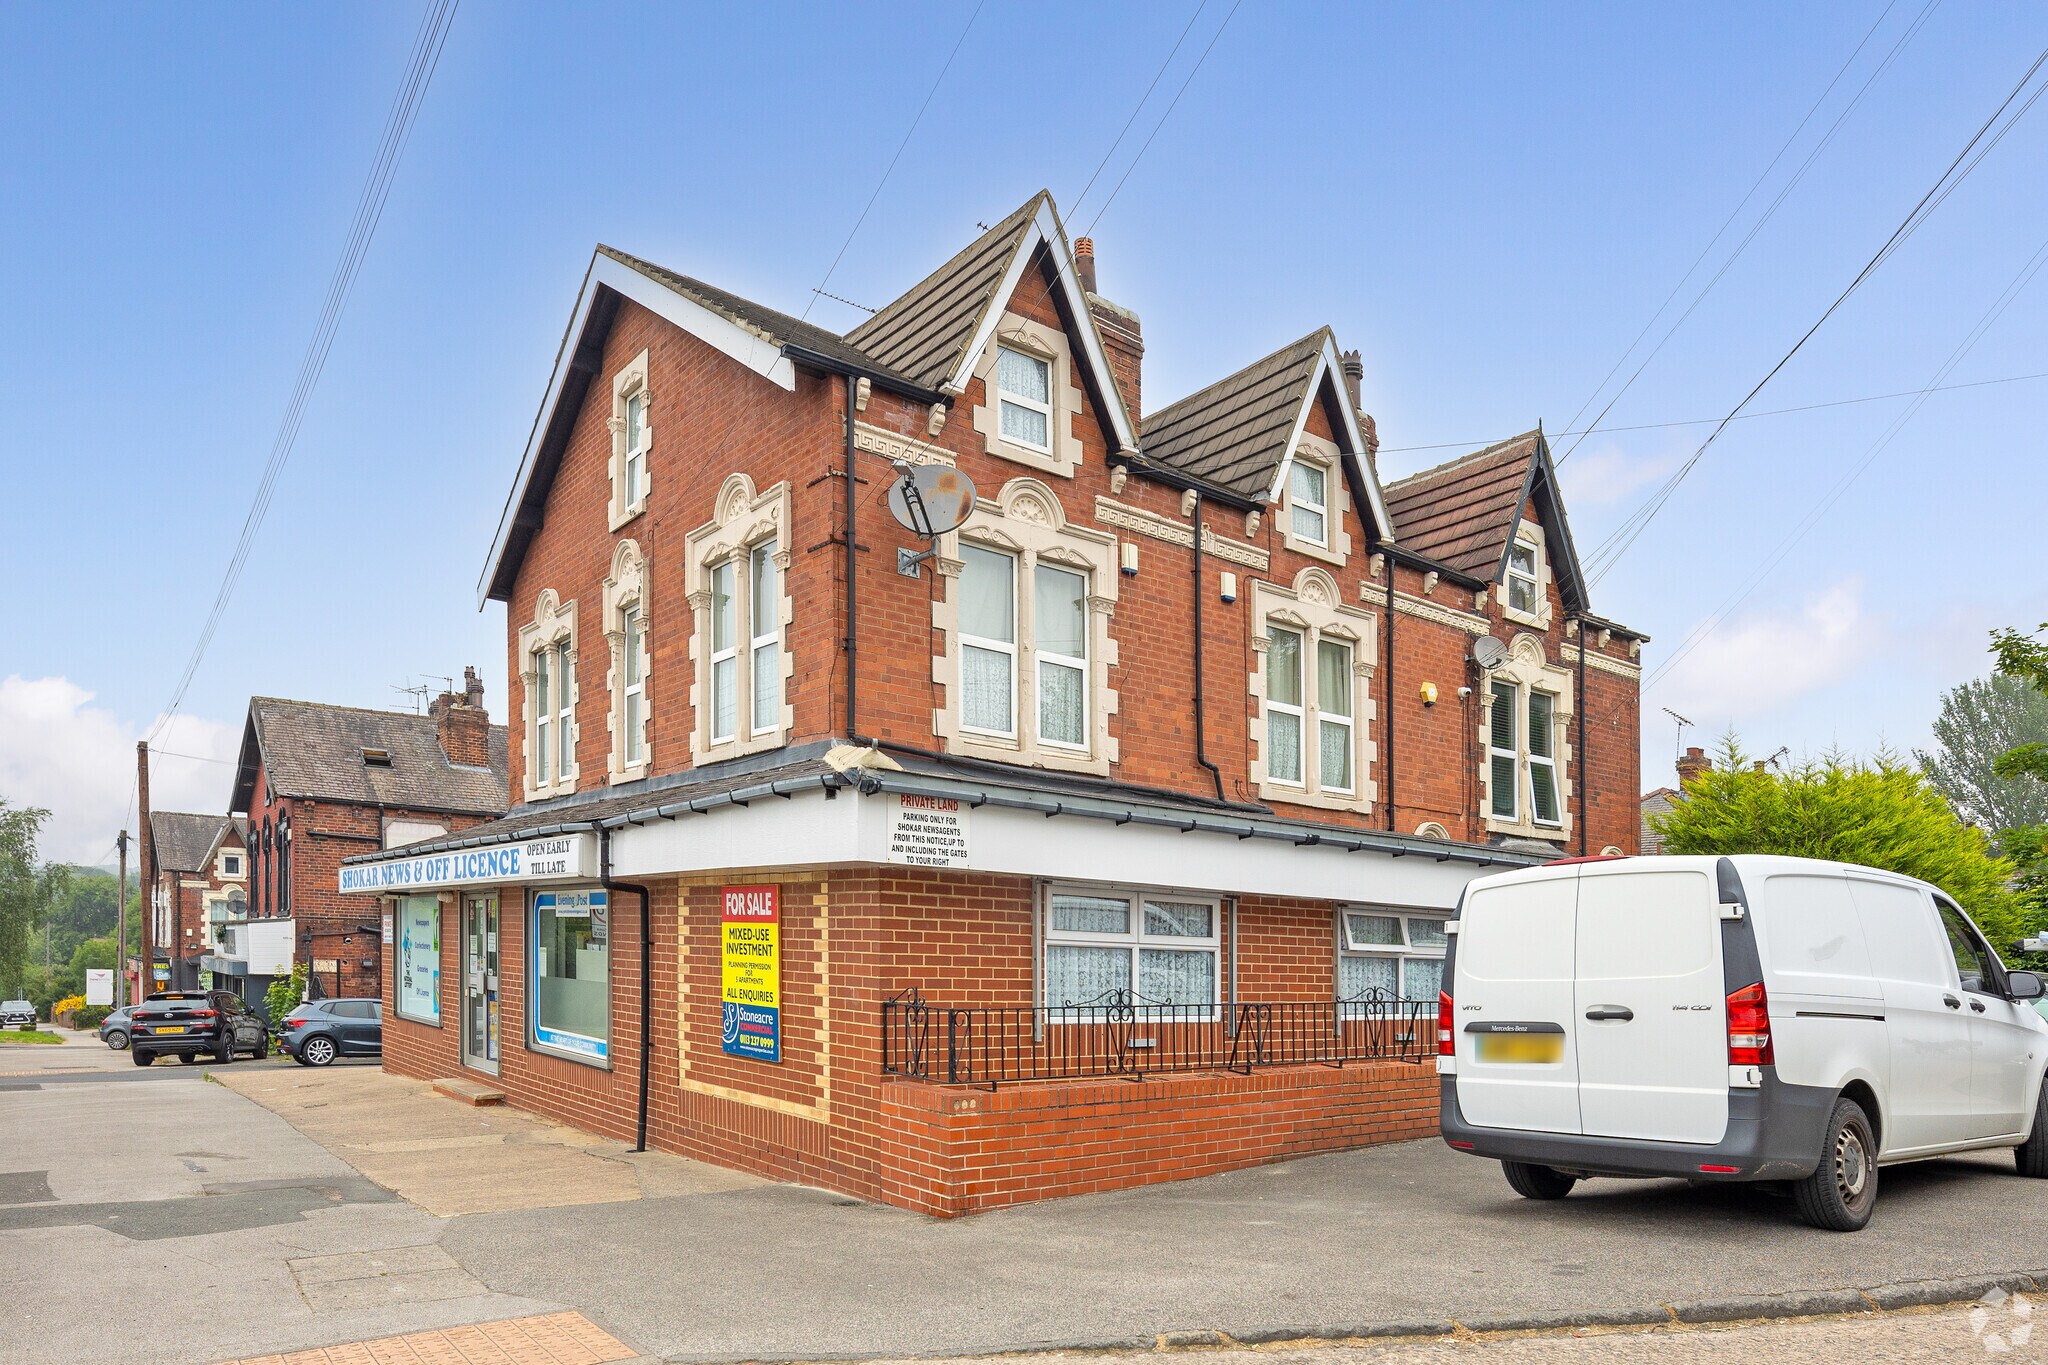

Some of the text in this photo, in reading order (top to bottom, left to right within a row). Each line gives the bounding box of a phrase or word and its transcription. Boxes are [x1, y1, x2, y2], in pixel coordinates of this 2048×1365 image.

[901, 794, 959, 811] PRIVATE LAND
[903, 812, 957, 825] PARKING ONLY FOR
[897, 822, 961, 837] SHOKAR NEWSAGENTS
[893, 833, 911, 843] FROM
[912, 835, 925, 844] THIS
[957, 839, 965, 847] TO
[527, 840, 571, 856] OPEN EARLY
[891, 844, 968, 858] AND INCLUDING THE GATES
[342, 848, 520, 889] SHOKAR NEWS & OFF LICENCE
[531, 860, 566, 875] TILL LATE
[906, 855, 950, 867] TO YOUR RIGHT
[557, 893, 588, 908] Evening Post
[725, 892, 773, 916] FOR SALE
[728, 927, 770, 941] MIXED-USE
[726, 942, 774, 957] INVESTMENT
[728, 960, 772, 971] PLANNING PERMISSION
[744, 969, 753, 977] FOR
[738, 976, 764, 986] APARTMENTS
[726, 988, 774, 1003] ALL ENQUIRIES
[739, 1006, 774, 1025] Stoneacre
[740, 1022, 774, 1036] COMMERCIAL
[739, 1033, 751, 1045] 0113
[760, 1036, 775, 1049] 0999
